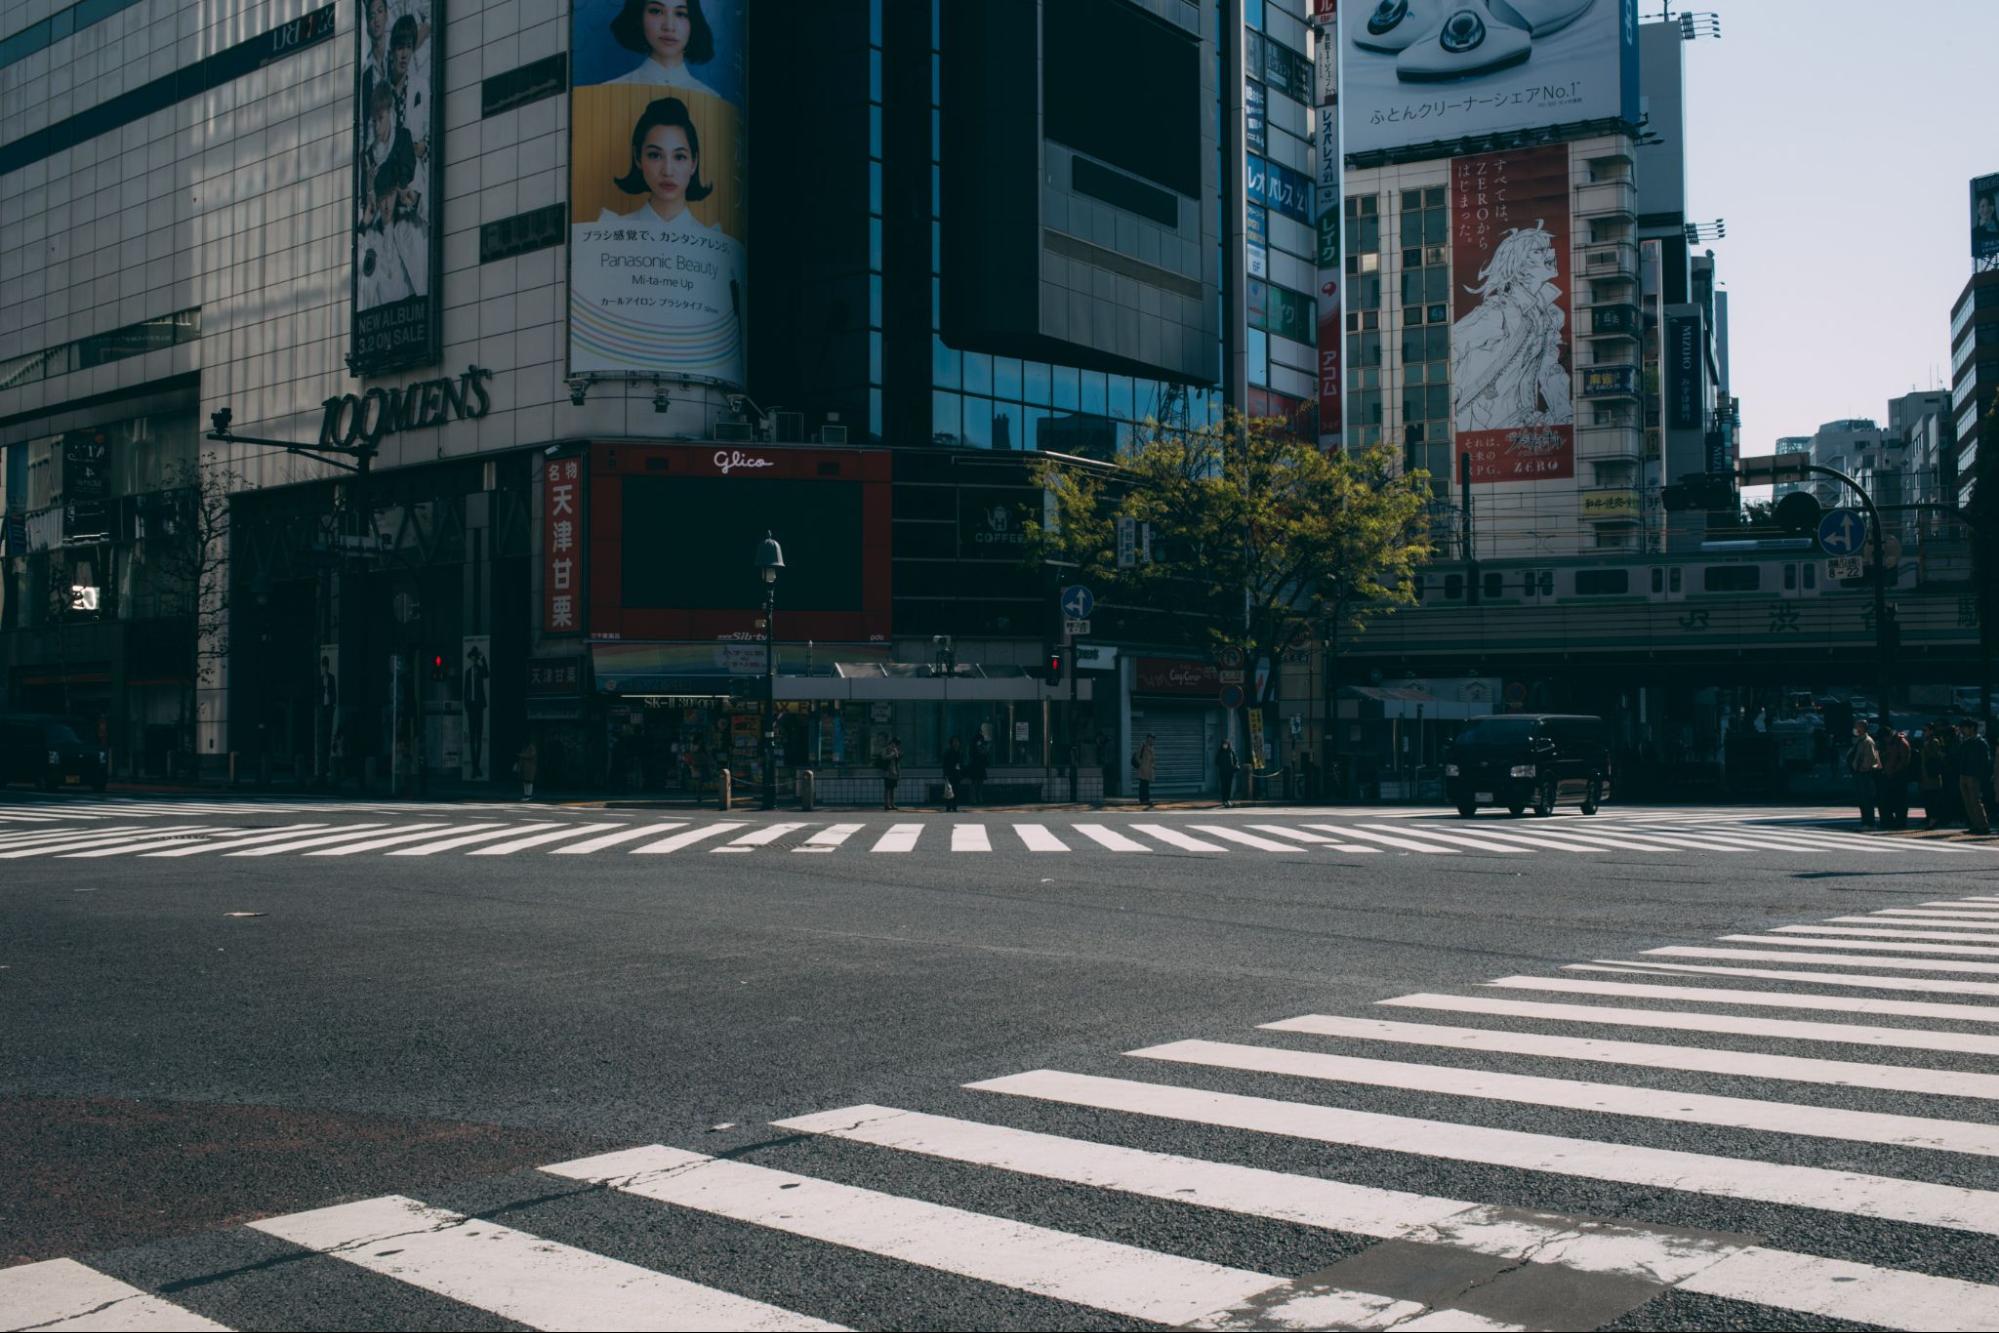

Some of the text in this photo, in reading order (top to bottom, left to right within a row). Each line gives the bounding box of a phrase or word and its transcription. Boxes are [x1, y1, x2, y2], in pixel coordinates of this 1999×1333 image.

[1322, 110, 1333, 183] レオパレス21
[1458, 163, 1472, 243] はじまった。
[1476, 162, 1490, 250] ZEROから
[1322, 217, 1335, 261] レイク
[600, 252, 719, 280] Panasonic Beauty
[632, 274, 695, 291] Mi-ta-me Up
[358, 301, 425, 335] NEW ALBUM
[376, 331, 391, 350] ON
[393, 323, 425, 346] SALE
[1681, 325, 1692, 370] MIZUHO
[1322, 350, 1337, 396] アコム
[548, 462, 577, 481] 名物
[713, 450, 775, 474] Glico
[1514, 460, 1559, 473] ZERO
[552, 484, 573, 627] 天津甘栗
[1679, 610, 1709, 632] JR
